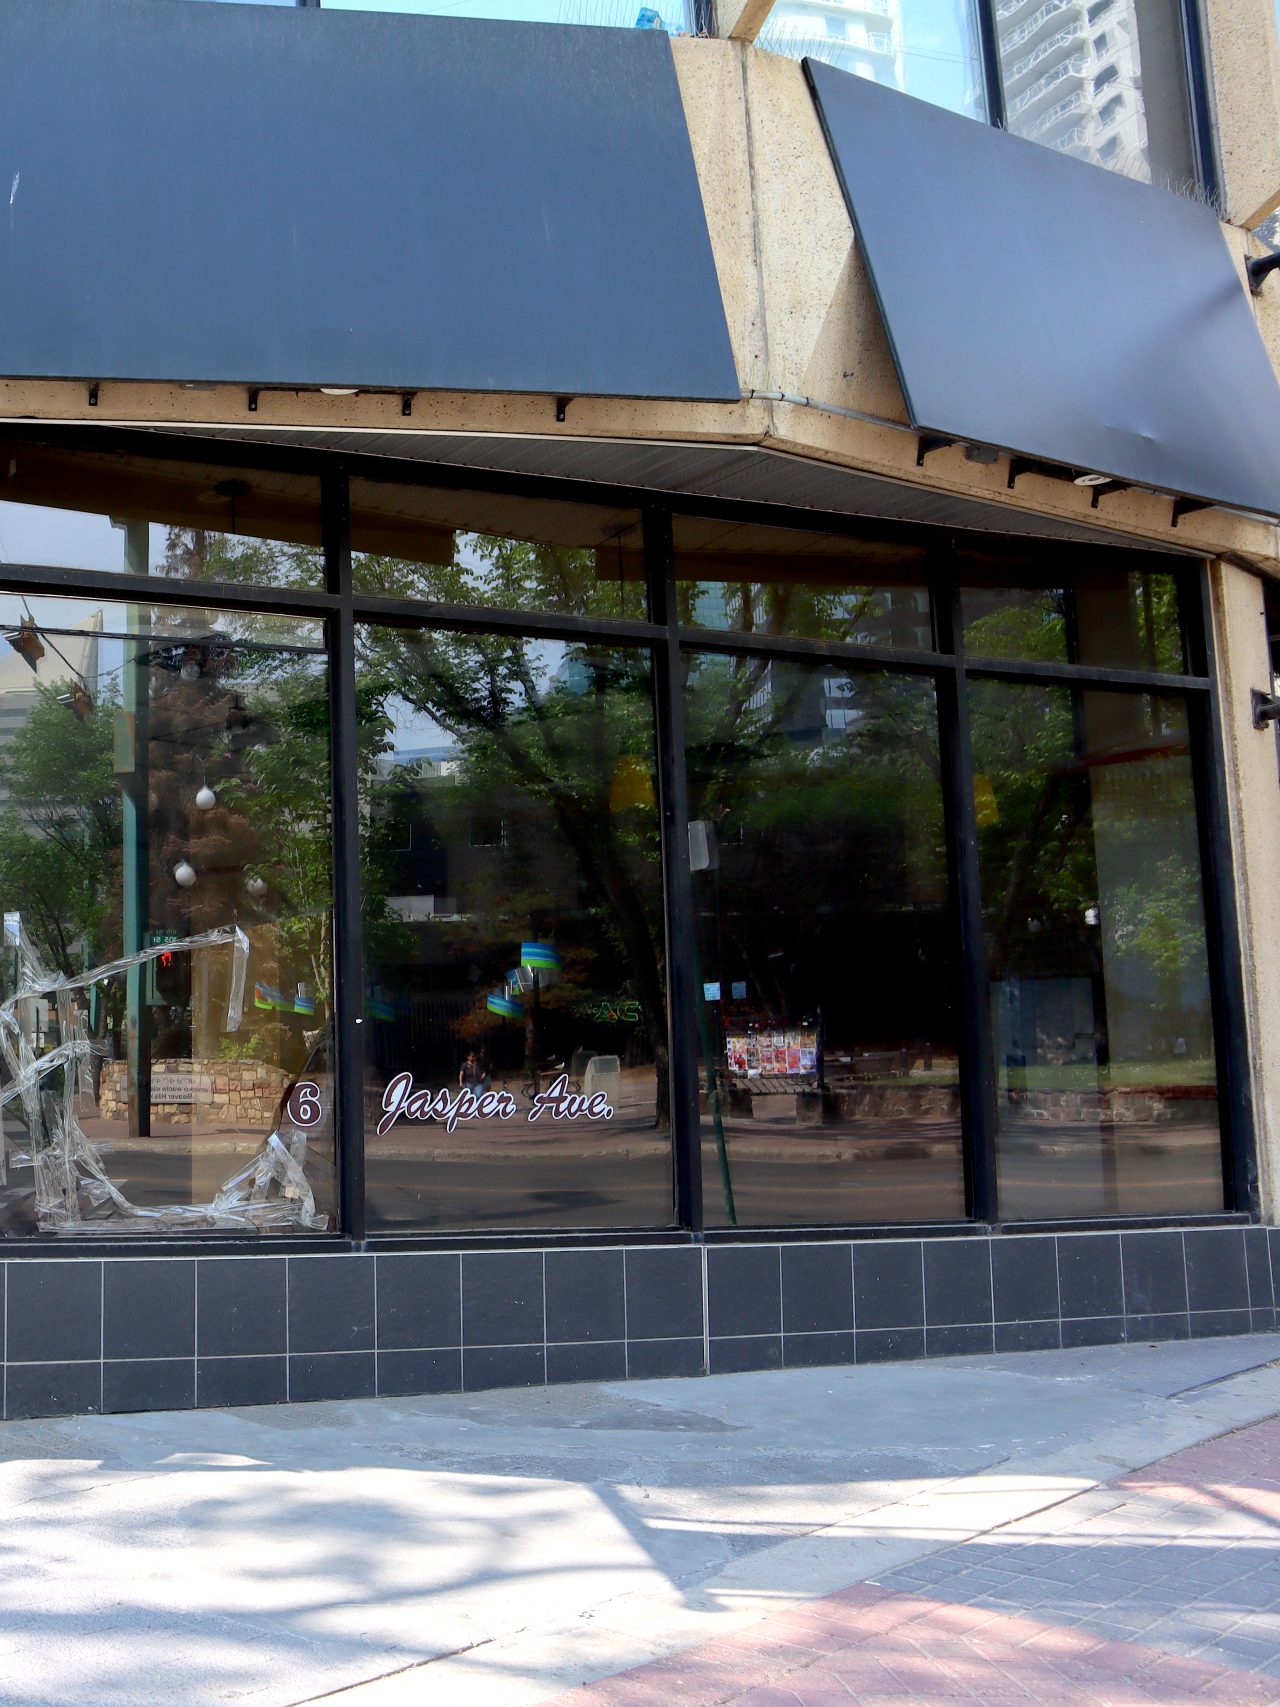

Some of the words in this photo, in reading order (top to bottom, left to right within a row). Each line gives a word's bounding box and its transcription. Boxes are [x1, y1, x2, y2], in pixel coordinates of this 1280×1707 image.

[287, 1081, 321, 1127] 6
[376, 1071, 517, 1136] Jasper
[527, 1073, 614, 1122] Ave.
